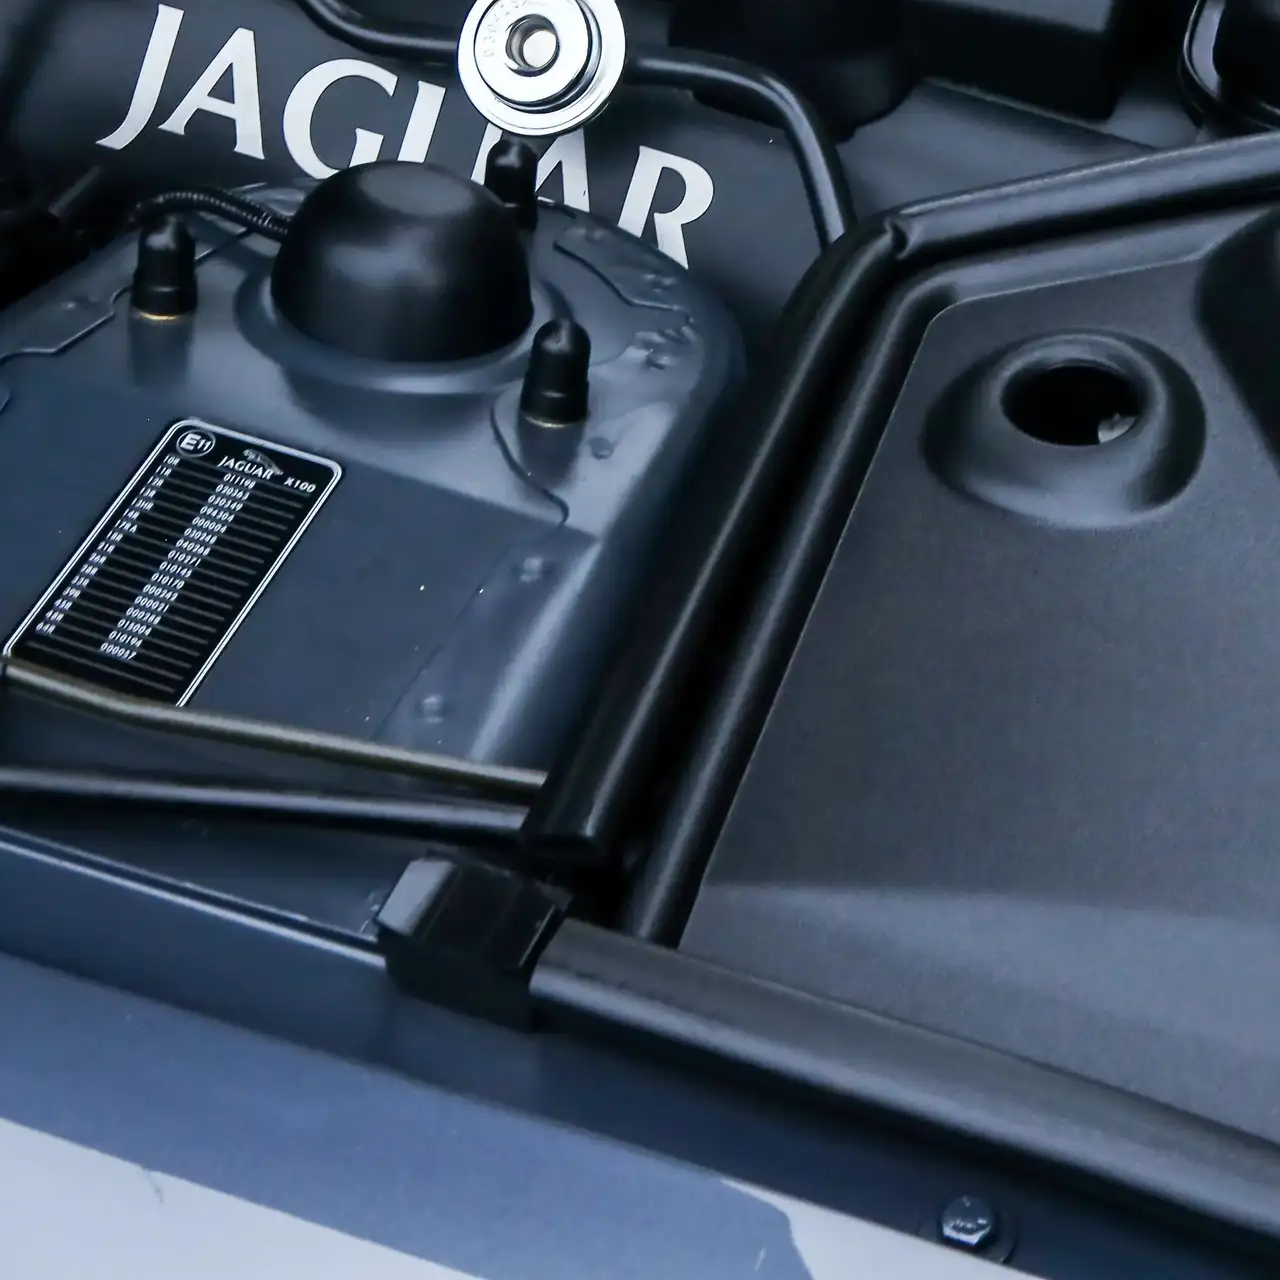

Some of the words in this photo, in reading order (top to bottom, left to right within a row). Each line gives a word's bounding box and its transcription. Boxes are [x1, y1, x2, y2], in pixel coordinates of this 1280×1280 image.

[156, 466, 172, 476] 11R
[217, 456, 274, 480] JAGUAR
[284, 477, 316, 493] X100
